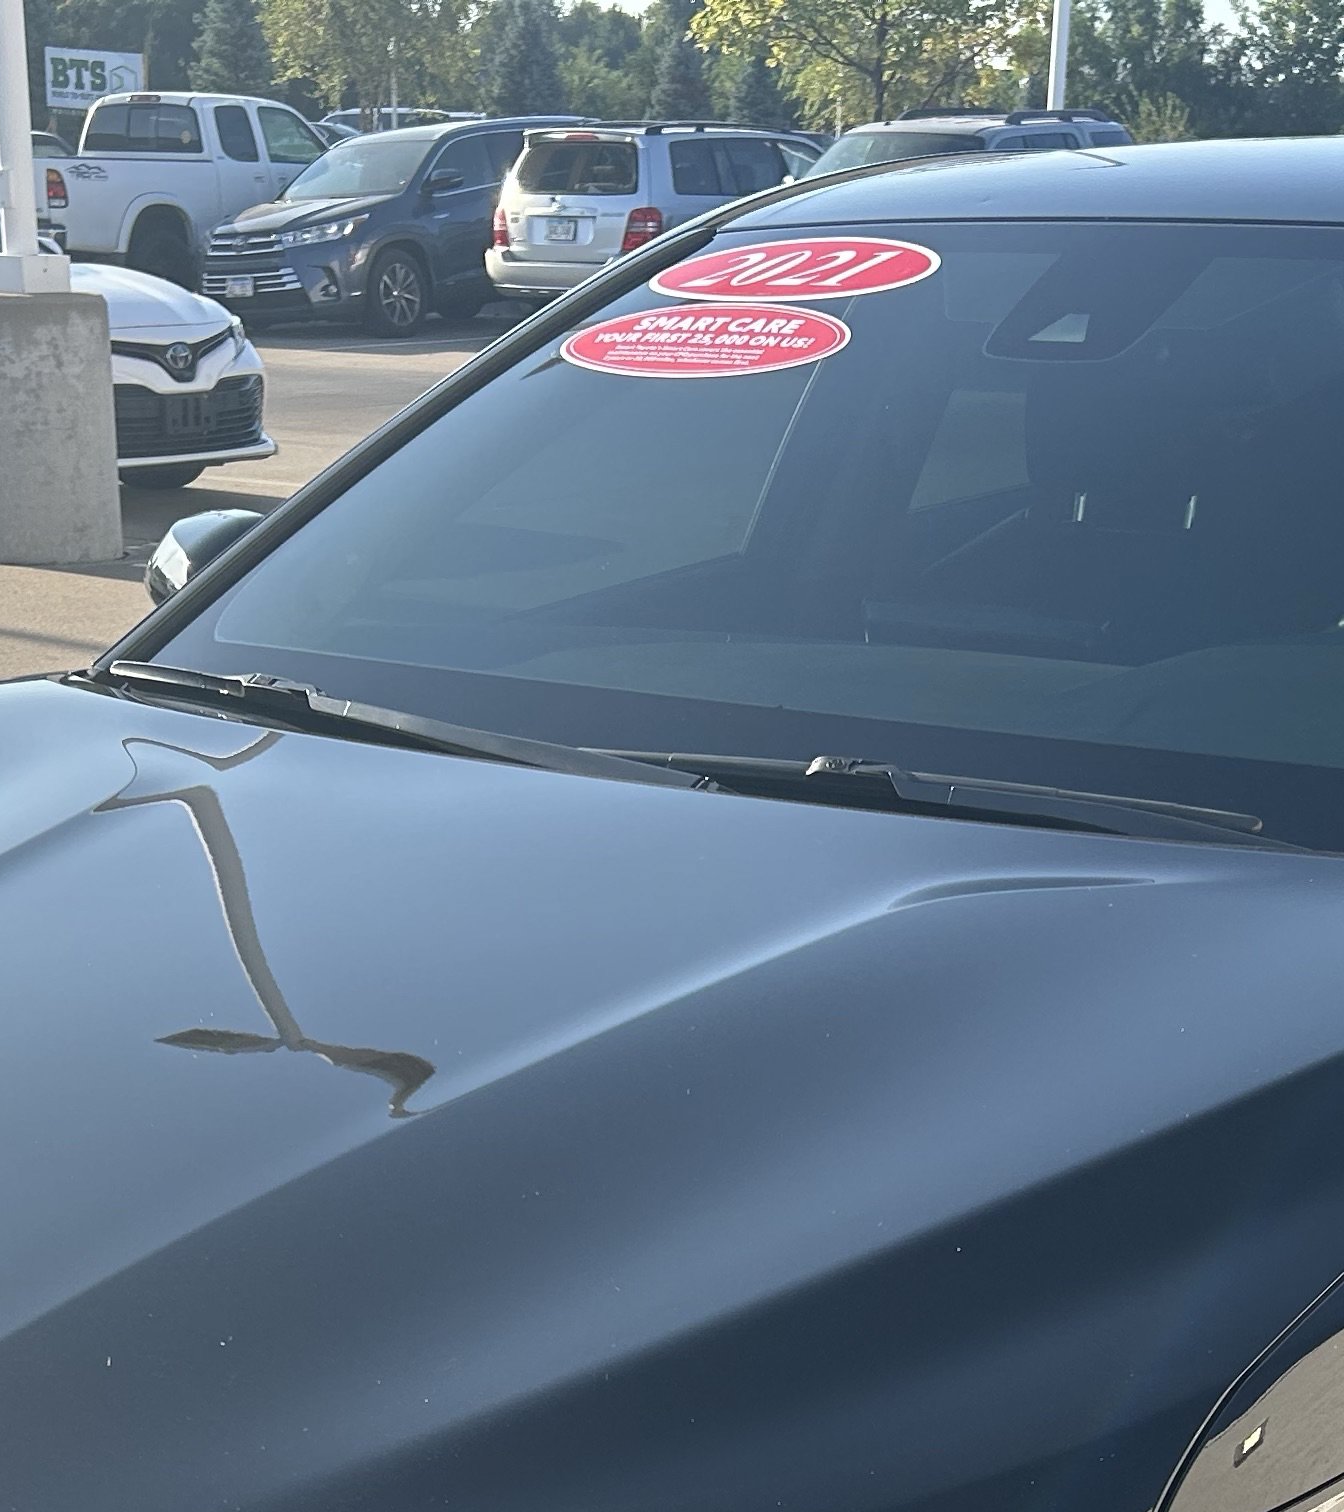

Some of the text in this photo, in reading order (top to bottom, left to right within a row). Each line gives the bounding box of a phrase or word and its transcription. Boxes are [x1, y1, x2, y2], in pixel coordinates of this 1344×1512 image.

[50, 57, 108, 92] BTS
[679, 250, 904, 288] 2021
[633, 316, 806, 334] SMART CARE
[594, 332, 815, 349] YOUR FIRST 25,000 ON US!
